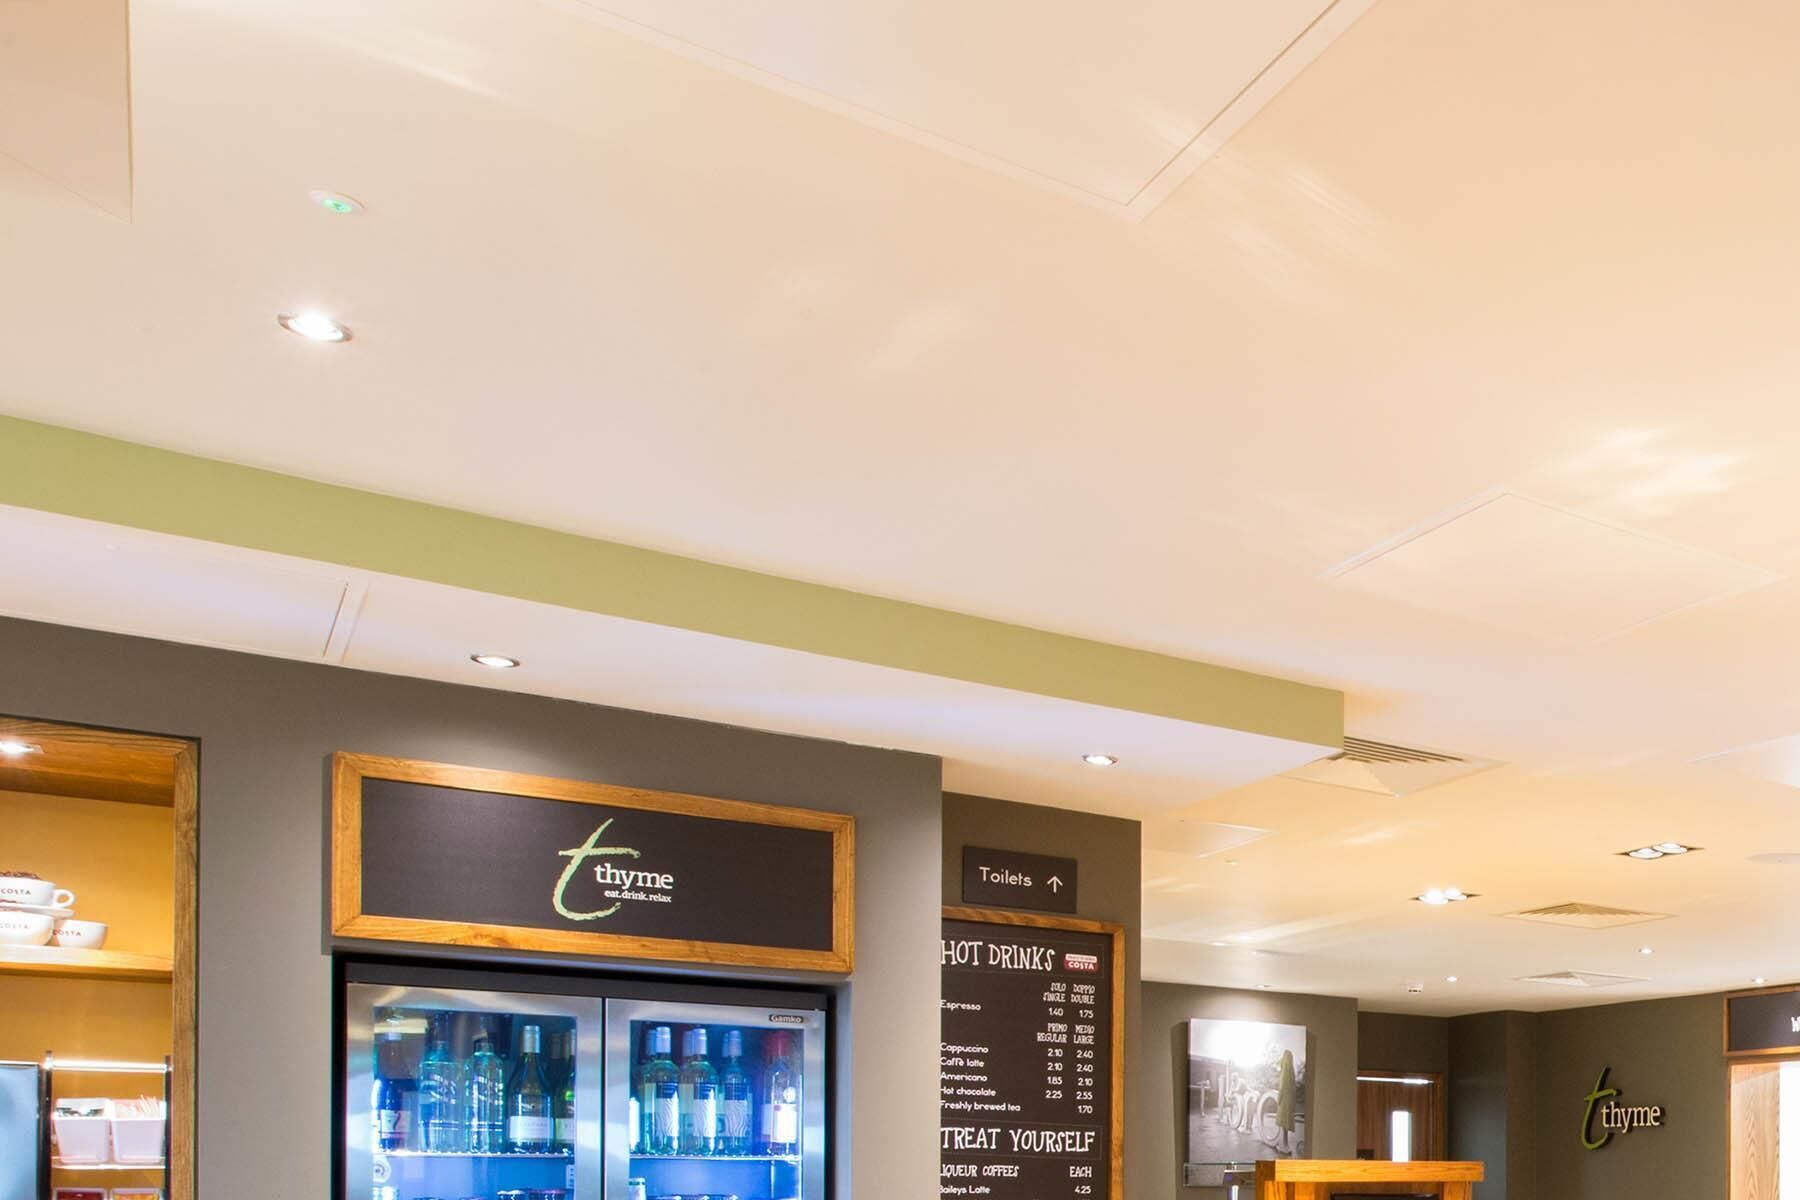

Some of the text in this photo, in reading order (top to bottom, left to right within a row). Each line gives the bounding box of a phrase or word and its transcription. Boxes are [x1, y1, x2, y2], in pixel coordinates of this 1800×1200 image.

[594, 863, 674, 889] thyme
[979, 867, 1032, 887] Toilets
[941, 941, 1055, 971] HOT DRINKS
[1068, 962, 1095, 970] COSTA
[1051, 982, 1066, 992] SOLO
[1043, 992, 1095, 1004] SINGLE DOUBLE
[940, 999, 981, 1011] Espresso
[1047, 1023, 1095, 1034] PRIMO MEDIO
[1037, 1033, 1094, 1045] REGULAR LARGE
[940, 1042, 989, 1054] Cappuccino
[967, 1059, 984, 1067] latte
[940, 1071, 988, 1082] Americano
[956, 1088, 996, 1097] chocolate
[974, 1103, 1006, 1111] brewed
[1008, 1103, 1021, 1112] tea
[1601, 1101, 1661, 1134] thyme
[941, 1127, 1095, 1152] TREAT YOURSELF
[983, 1165, 1019, 1177] COFFEES
[1070, 1166, 1092, 1178] EACH
[969, 1185, 990, 1194] Latte
